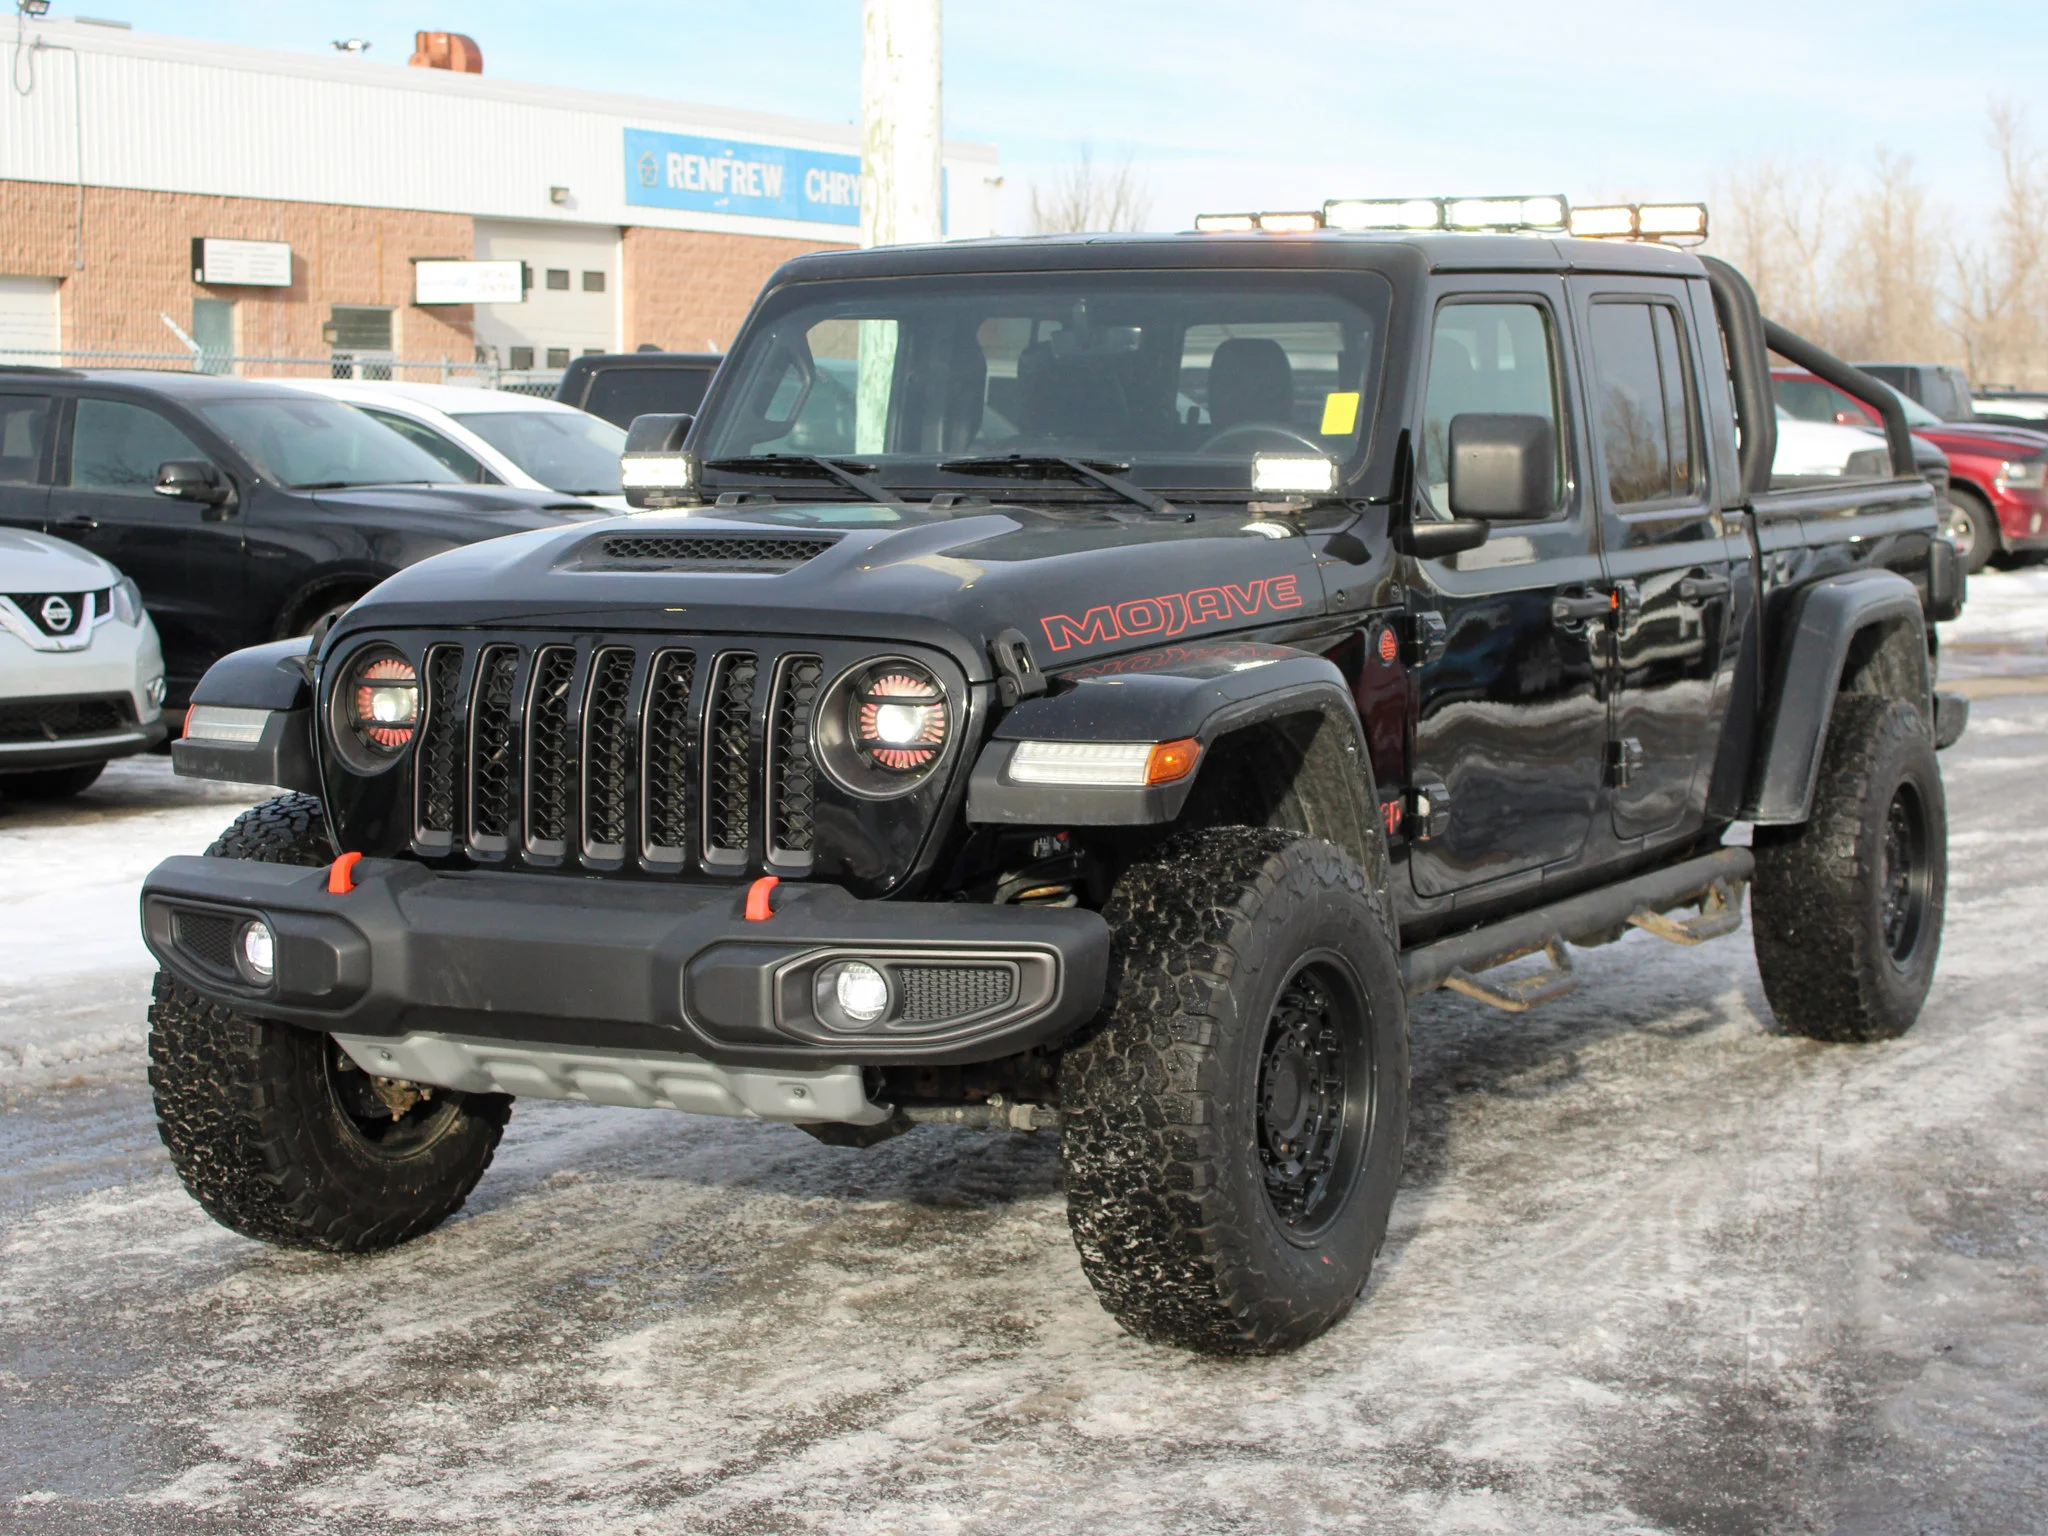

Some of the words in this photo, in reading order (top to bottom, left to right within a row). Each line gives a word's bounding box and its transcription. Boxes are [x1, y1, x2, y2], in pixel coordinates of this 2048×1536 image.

[667, 153, 782, 198] RENFREW
[805, 168, 861, 206] CHRY
[1041, 574, 1302, 651] MOJAVE
